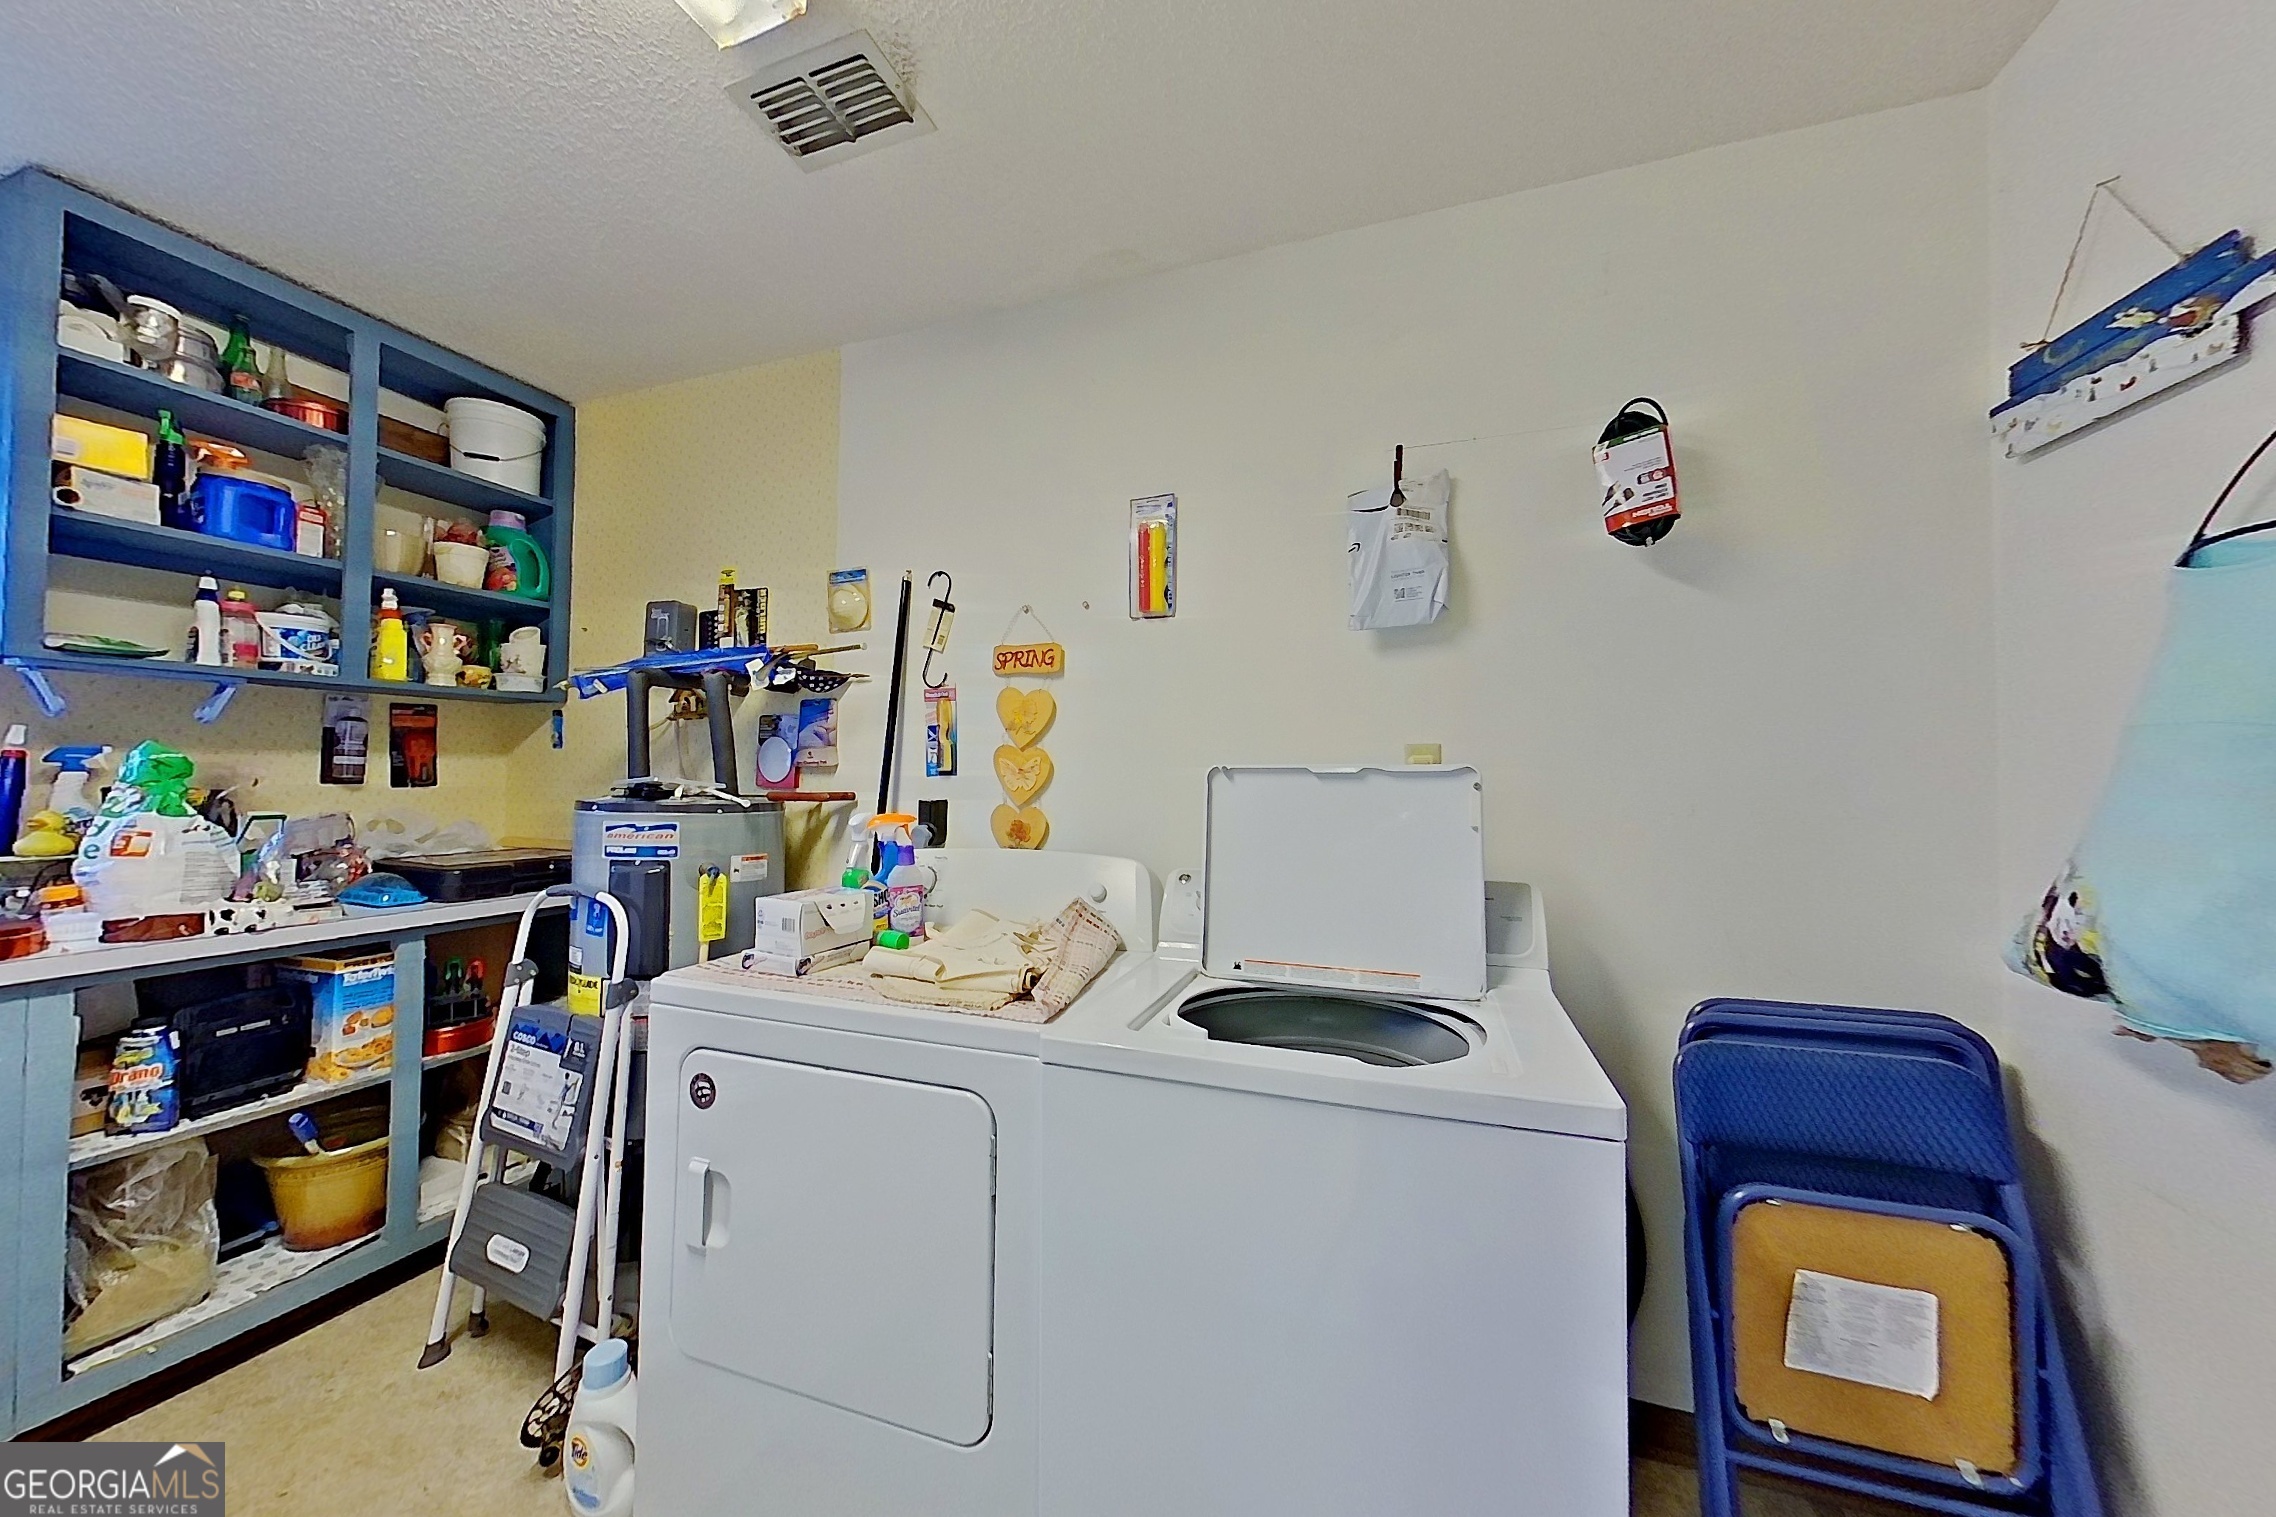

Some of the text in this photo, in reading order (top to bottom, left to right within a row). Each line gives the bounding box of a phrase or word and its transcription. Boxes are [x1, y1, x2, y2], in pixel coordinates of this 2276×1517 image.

[994, 648, 1055, 670] SPRING
[606, 832, 675, 840] american
[512, 1030, 536, 1046] COSCO
